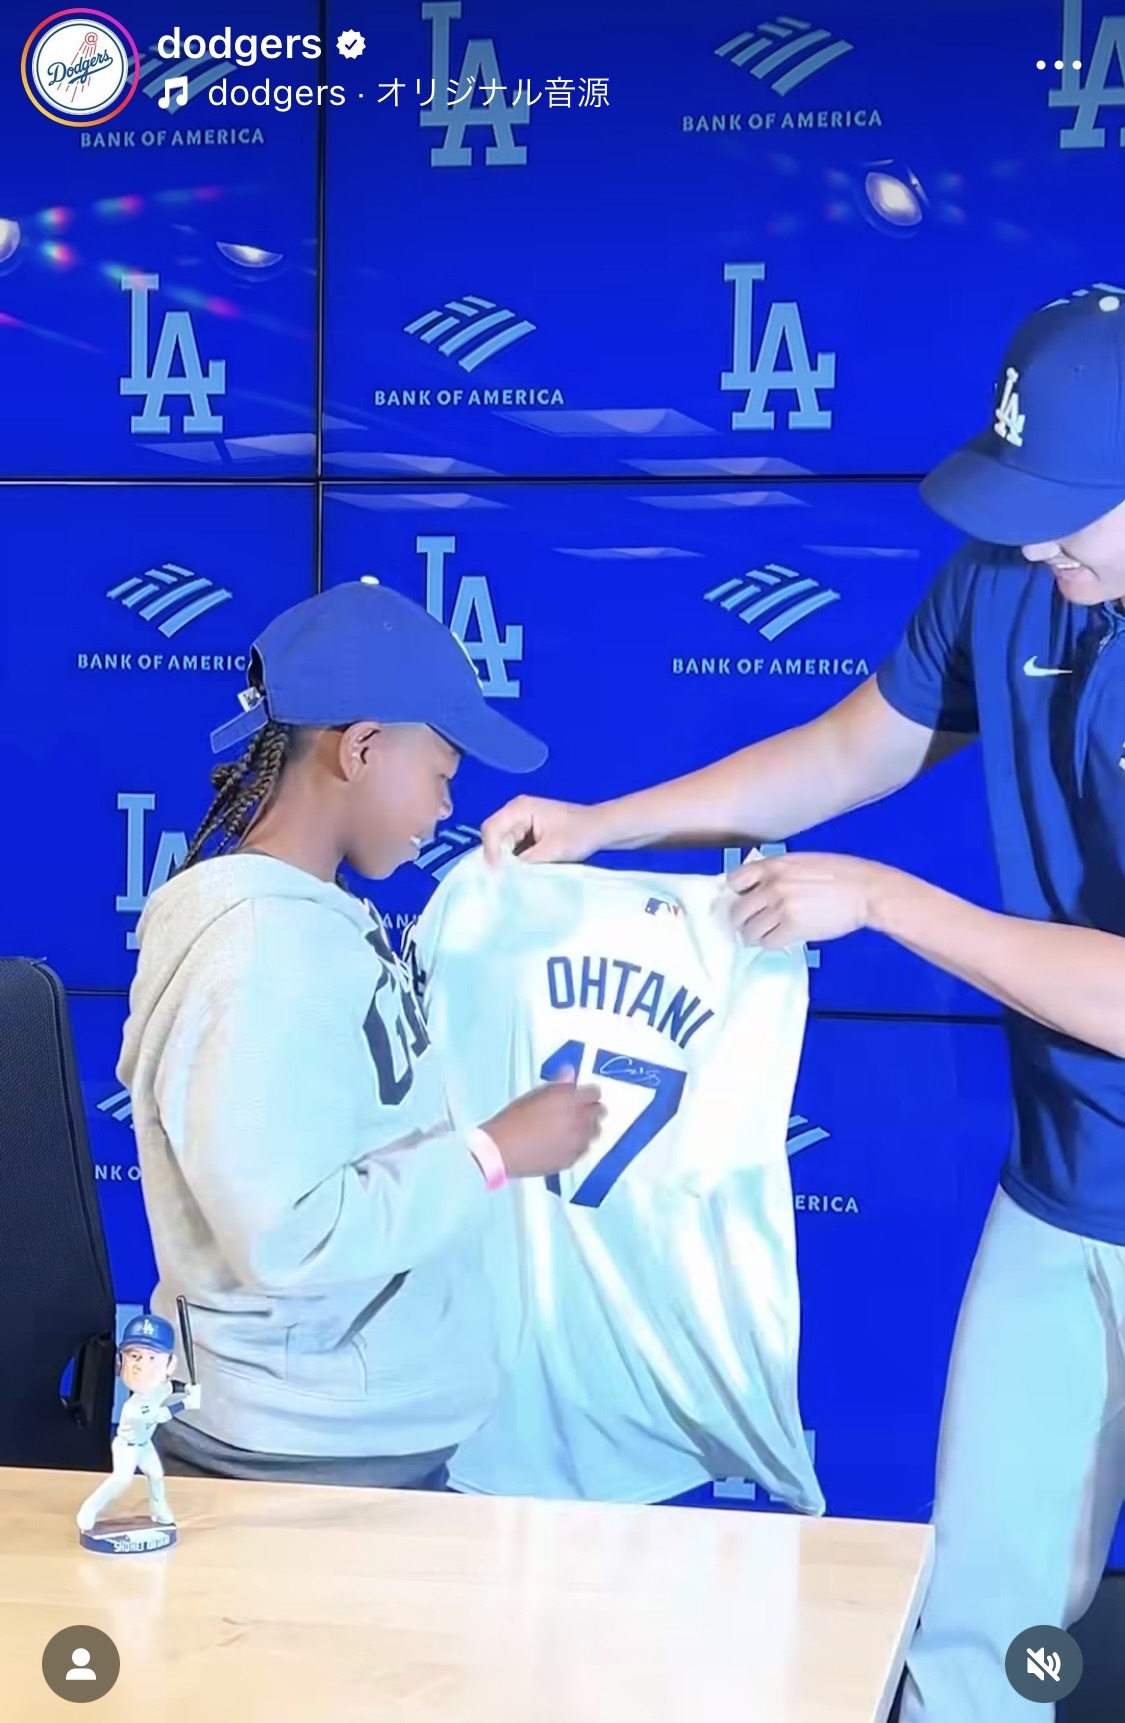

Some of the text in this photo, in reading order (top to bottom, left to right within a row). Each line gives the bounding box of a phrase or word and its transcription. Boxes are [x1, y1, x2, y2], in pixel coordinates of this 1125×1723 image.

[420, 1, 530, 168] LA
[682, 110, 882, 132] BANK OF AMERICA
[80, 128, 264, 148] BANK OF AMERICA
[120, 274, 226, 434] LA
[721, 263, 836, 430] LA
[375, 389, 564, 406] BANK OF AMERICA
[994, 367, 1025, 447] LA
[78, 654, 246, 671] BANK OF AMERIC
[672, 658, 870, 676] BANK OF AMERICA
[547, 956, 715, 1049] OHTANI
[795, 1195, 858, 1213] ERICA
